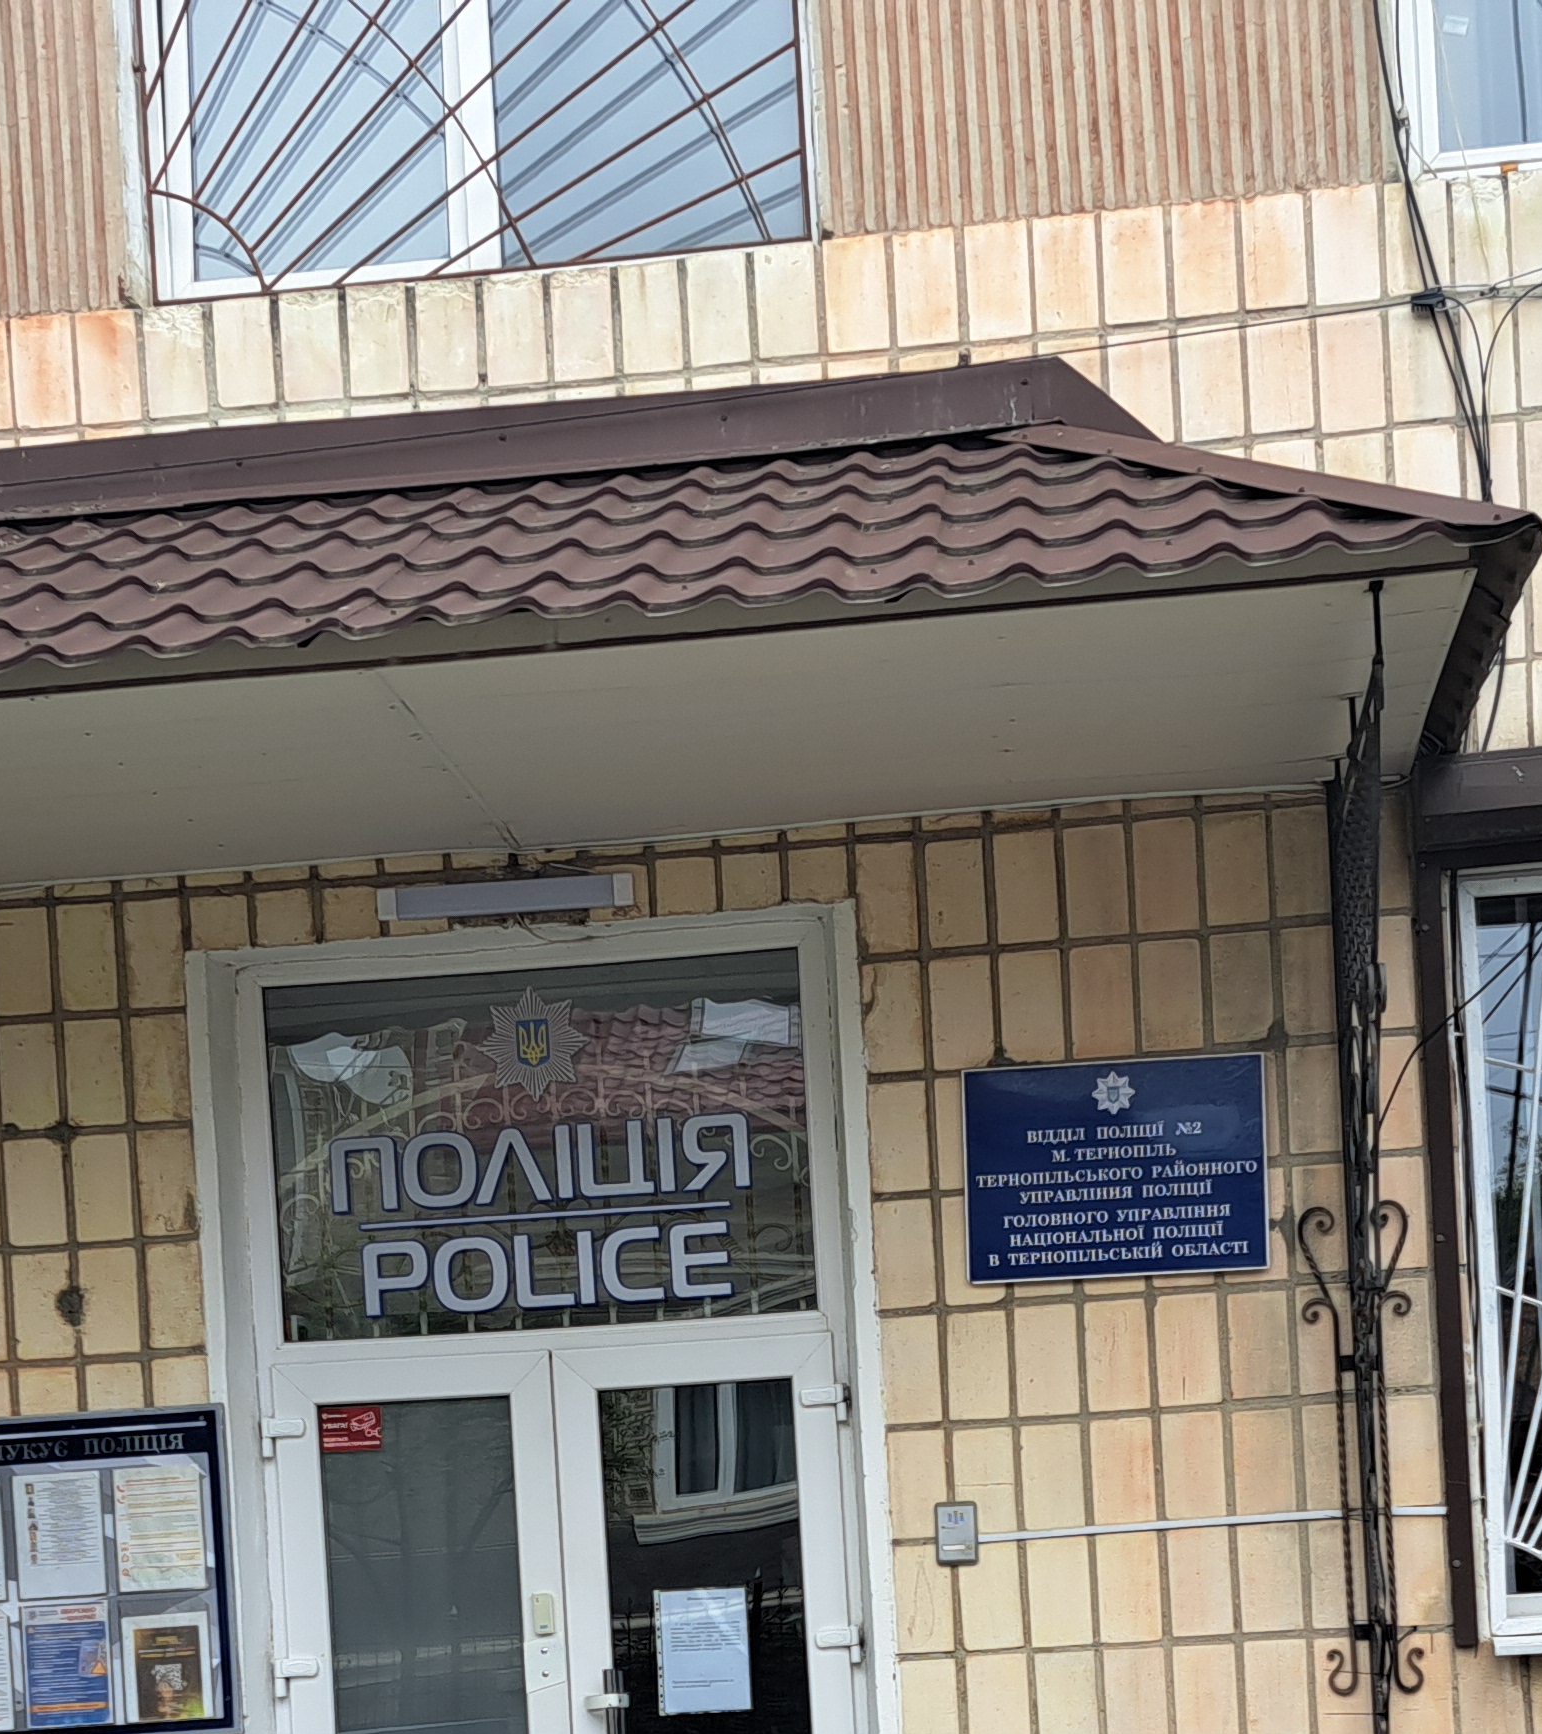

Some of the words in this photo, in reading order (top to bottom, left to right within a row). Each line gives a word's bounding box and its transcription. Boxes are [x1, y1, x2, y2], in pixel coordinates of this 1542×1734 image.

[1026, 1127, 1085, 1146] ВІДДІЛ
[1096, 1121, 1164, 1141] ПОЛІЦІЇ
[1175, 1121, 1202, 1137] №2
[329, 1112, 752, 1216] ПОЛІЦІЯ
[1051, 1149, 1071, 1163] М.
[1075, 1144, 1177, 1162] ТЕРНОПІЛЬ
[975, 1166, 1143, 1189] ТЕРНОПІЛЬСЬКОГО
[1151, 1160, 1258, 1178] РАЙОННОГО
[1019, 1186, 1133, 1205] УПРАВЛІННЯ
[1142, 1179, 1213, 1200] ПОЛІЦІЇ
[1003, 1210, 1109, 1229] ГОЛОВНОГО
[1115, 1203, 1231, 1223] УПРАВЛІННЯ
[1009, 1224, 1146, 1248] НАЦІОНАЛЬНОЇ
[1153, 1220, 1224, 1241] ПОЛІЦІЇ
[988, 1254, 1000, 1267] В
[1008, 1242, 1163, 1266] ТЕРНОПІЛЬСЬКІЙ
[1171, 1241, 1250, 1258] ОБЛАСТІ
[360, 1219, 735, 1319] POLICE
[83, 1432, 185, 1457] ПОЛІЦІЯ
